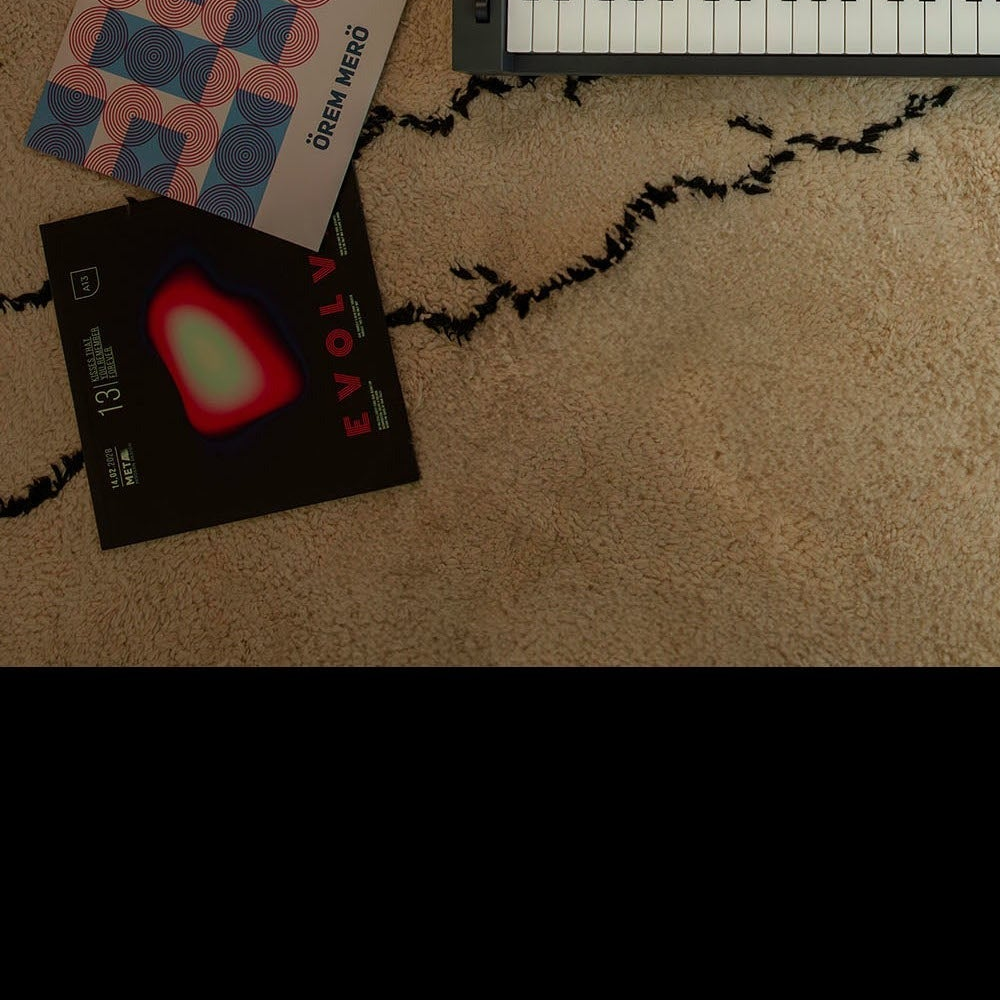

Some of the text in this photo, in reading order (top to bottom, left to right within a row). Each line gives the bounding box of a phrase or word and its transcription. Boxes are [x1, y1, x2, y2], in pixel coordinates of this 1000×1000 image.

[306, 24, 369, 151] ÖREM MERÖ
[103, 346, 117, 379] FOREVER
[308, 255, 372, 437] EVOLV
[95, 388, 123, 416] 13
